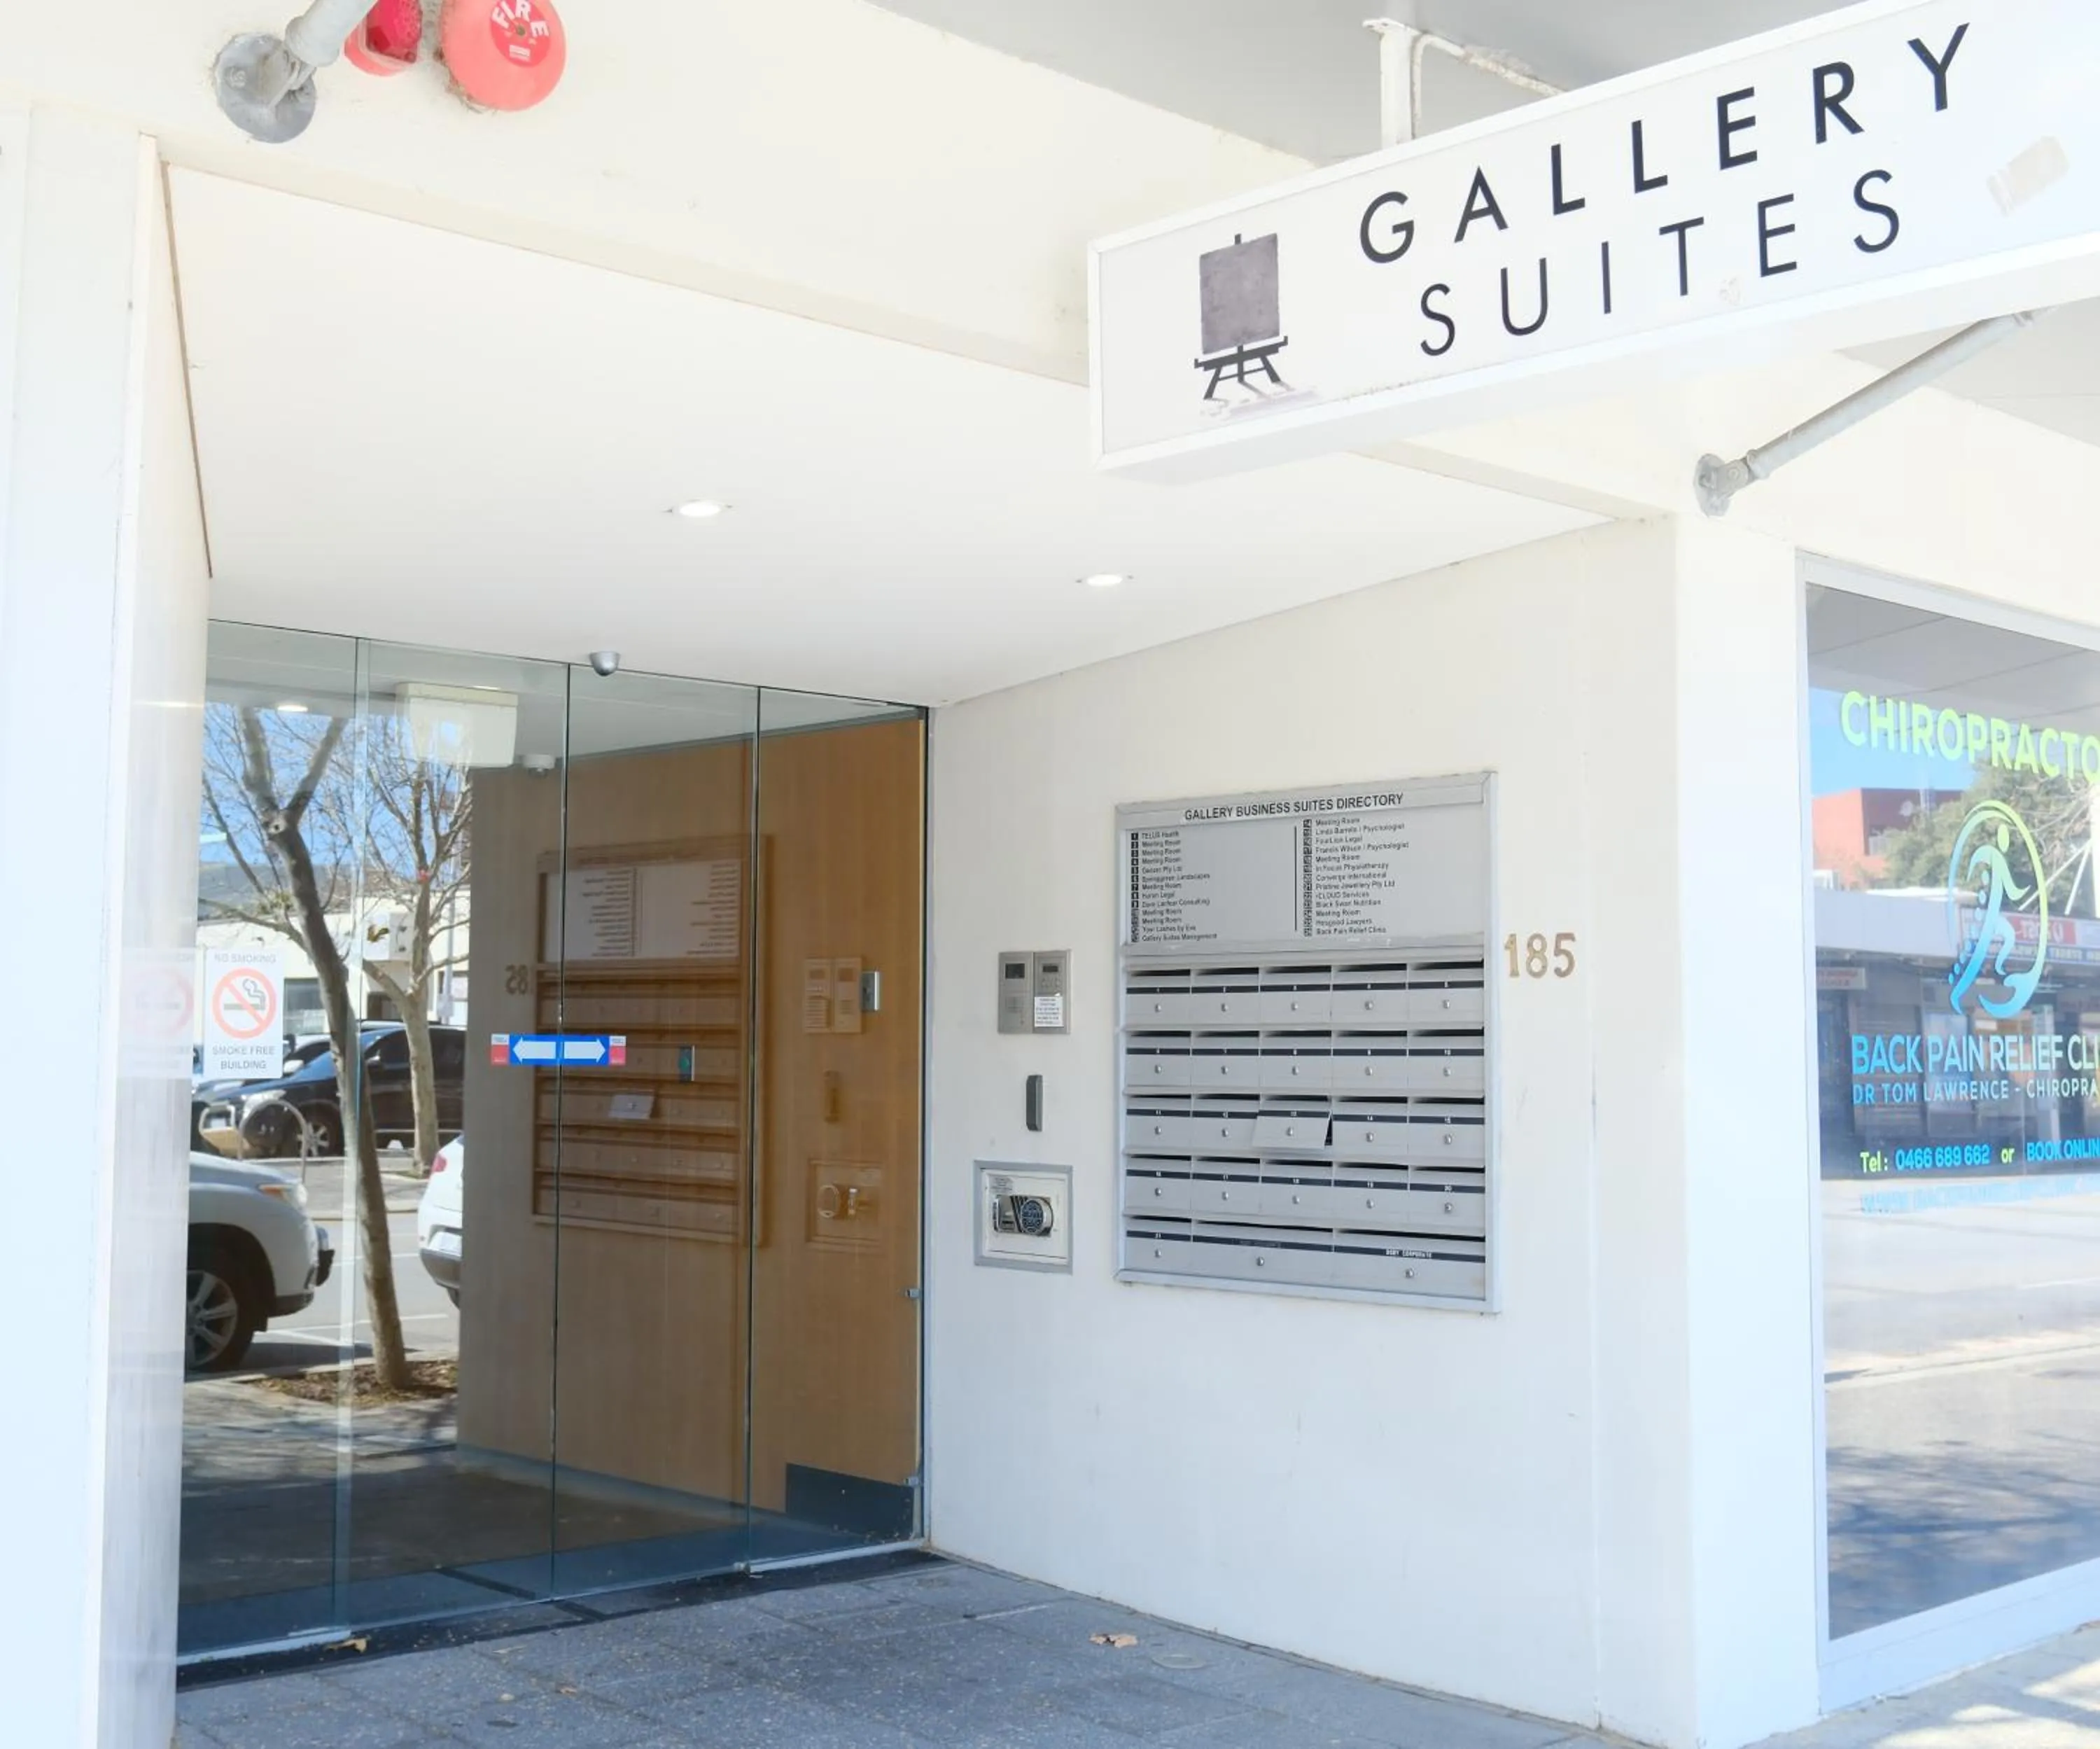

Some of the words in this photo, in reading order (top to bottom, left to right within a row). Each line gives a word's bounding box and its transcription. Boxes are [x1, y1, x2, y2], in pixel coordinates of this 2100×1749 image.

[491, 0, 550, 38] FIRE
[1359, 22, 1970, 264] GALLERY
[1420, 169, 1900, 356] SUITES
[1840, 690, 2100, 783] CHIROPRACTO
[1184, 807, 1233, 821] GALLERY
[1236, 802, 1291, 818] BUSINESS
[1294, 798, 1334, 814] SUITES
[1336, 793, 1404, 809] DIRECTORY
[214, 954, 228, 963] NO
[232, 954, 277, 963] SMOKING
[1504, 932, 1576, 979] 185
[213, 1046, 247, 1055] SMOKE
[250, 1045, 276, 1054] FREE
[220, 1060, 267, 1070] BUILDING
[1851, 1034, 1923, 1075] BACK
[1928, 1035, 1985, 1073] PAIN
[1989, 1034, 2064, 1071] RELIEF
[1853, 1084, 1875, 1105] DR
[1882, 1082, 1917, 1103] TOM
[1924, 1080, 2009, 1102] LAWRENCE
[2026, 1078, 2100, 1098] CHIROPRA
[1895, 1148, 1932, 1170] 0466
[1935, 1146, 1961, 1168] 689
[1964, 1144, 1990, 1165] 662
[2001, 1148, 2015, 1164] or
[2026, 1141, 2062, 1161] BOOK
